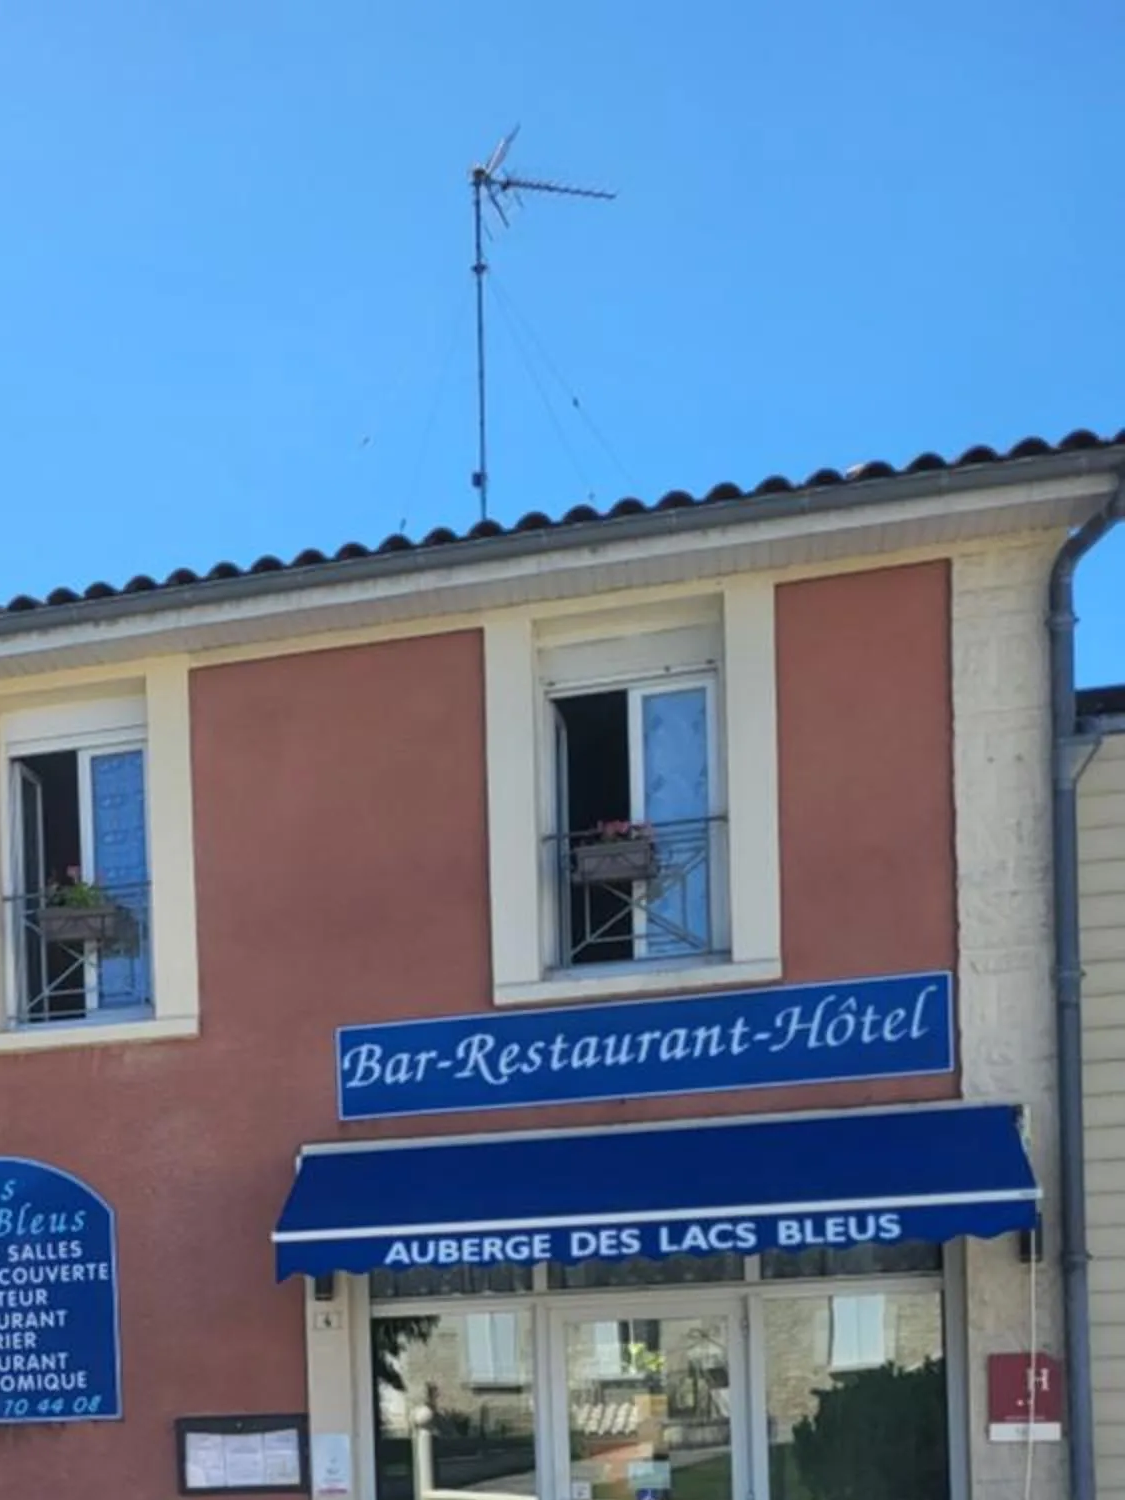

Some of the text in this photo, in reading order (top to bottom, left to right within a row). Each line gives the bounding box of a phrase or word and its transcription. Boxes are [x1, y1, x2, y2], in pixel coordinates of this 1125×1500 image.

[342, 984, 938, 1089] Bar-Restaurant-Hôtel
[7, 1240, 83, 1263] SALLES
[383, 1213, 902, 1265] AUBERGE DES LACS BLEUS
